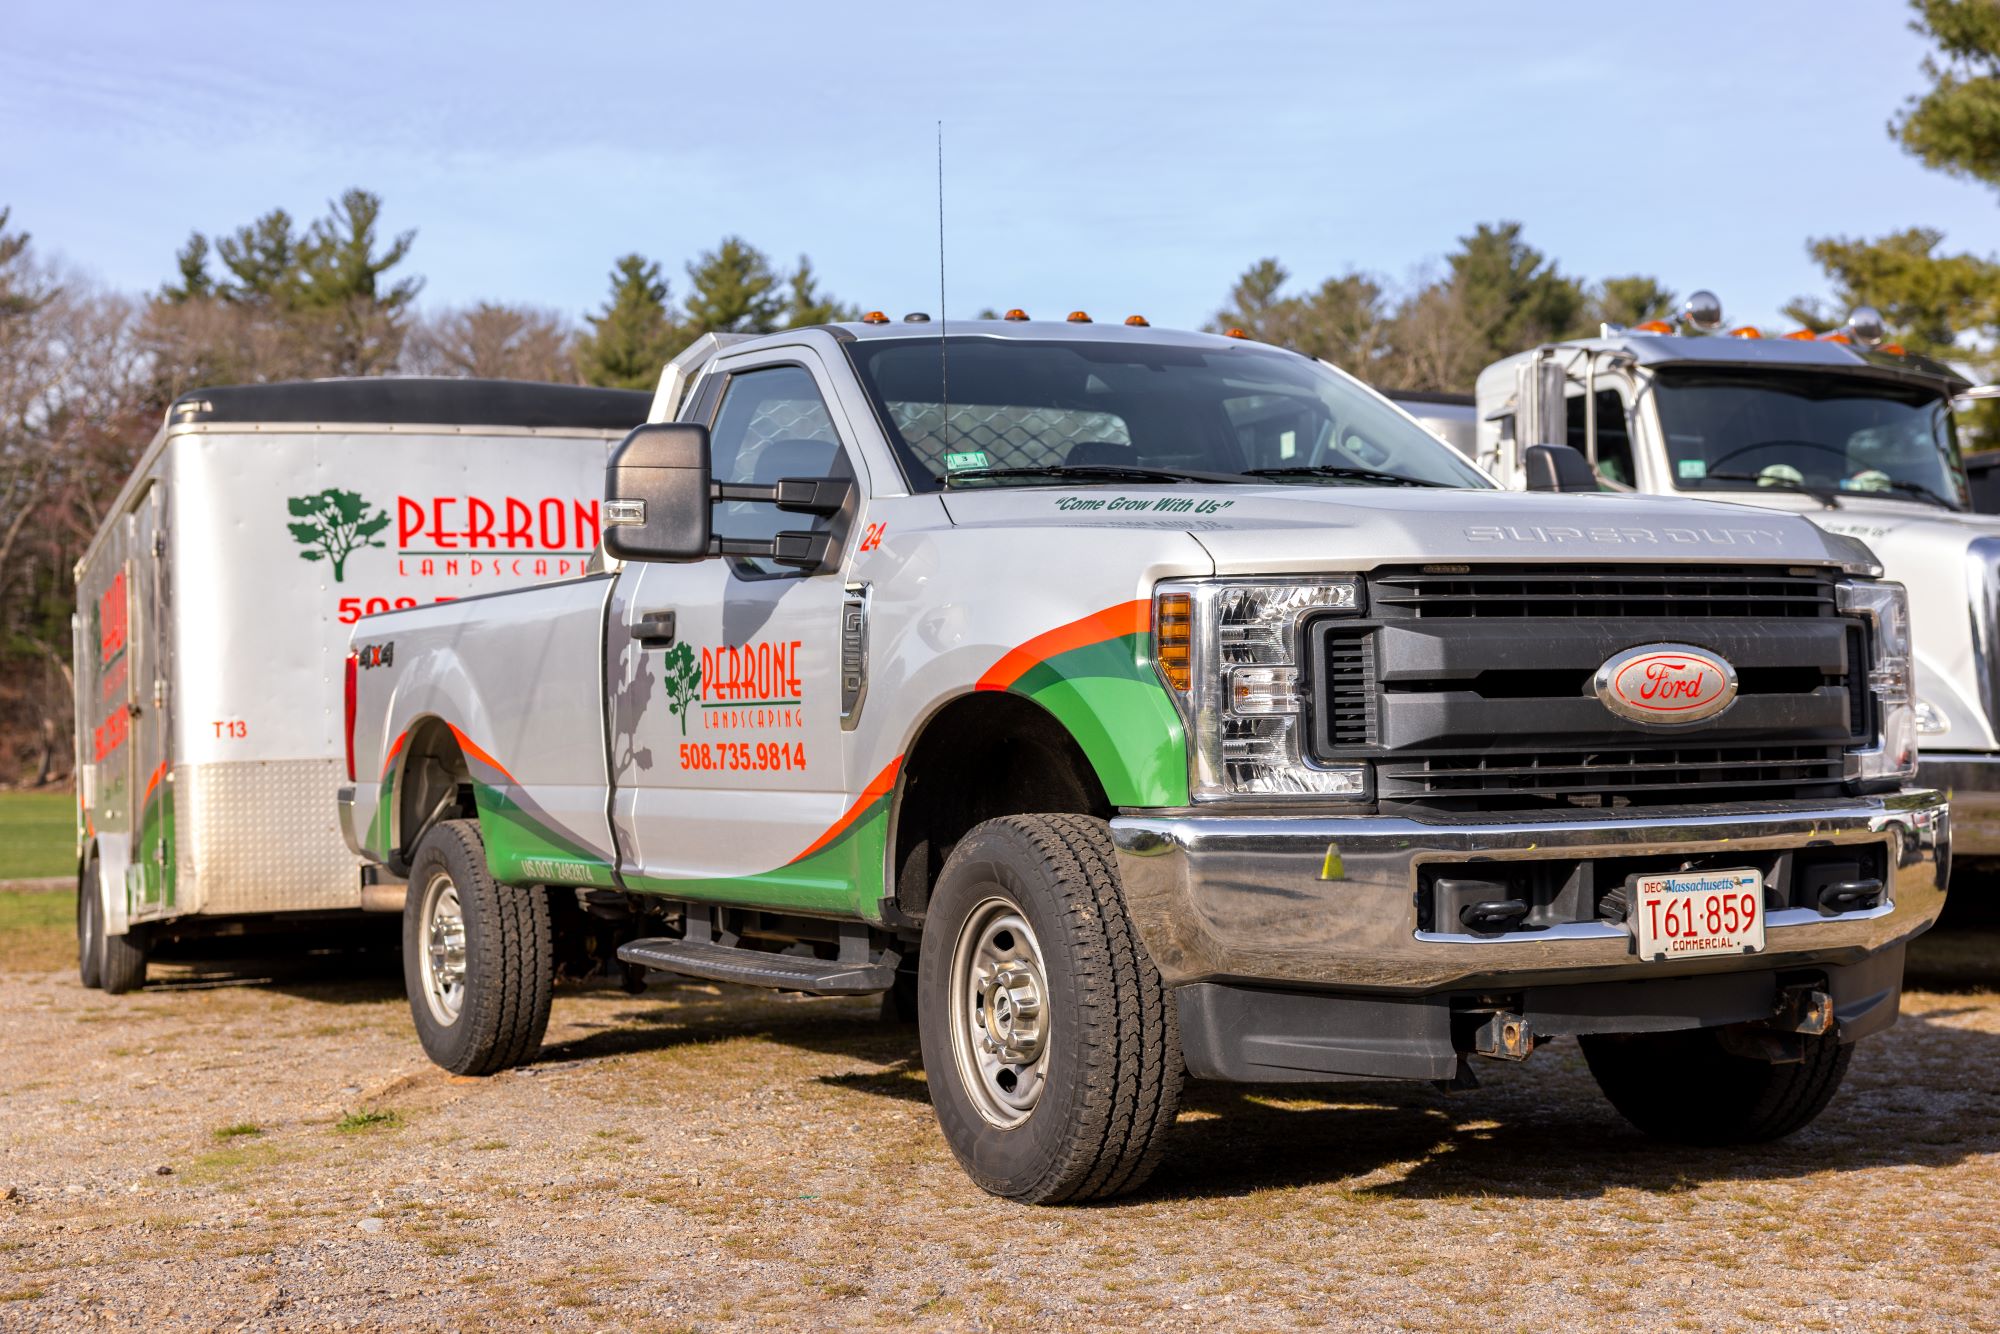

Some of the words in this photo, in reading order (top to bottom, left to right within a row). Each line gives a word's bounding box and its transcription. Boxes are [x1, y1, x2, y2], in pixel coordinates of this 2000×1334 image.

[1107, 496, 1154, 511] Grow
[1152, 497, 1194, 513] With
[397, 495, 601, 550] PERRON
[860, 521, 887, 552] 24
[1463, 526, 1658, 544] SUPER
[1661, 527, 1784, 545] DUTY
[398, 558, 586, 576] LANDSCAPI
[702, 640, 802, 701] PERRONE
[1640, 662, 1703, 699] Ford
[704, 708, 803, 729] LANDSCAPING
[679, 741, 807, 771] 508.735.9814
[521, 860, 537, 877] US
[535, 861, 556, 879] DOT
[1644, 882, 1662, 894] DEC
[1665, 878, 1734, 894] Massachusetts
[1672, 937, 1733, 952] COMMERCIAL
